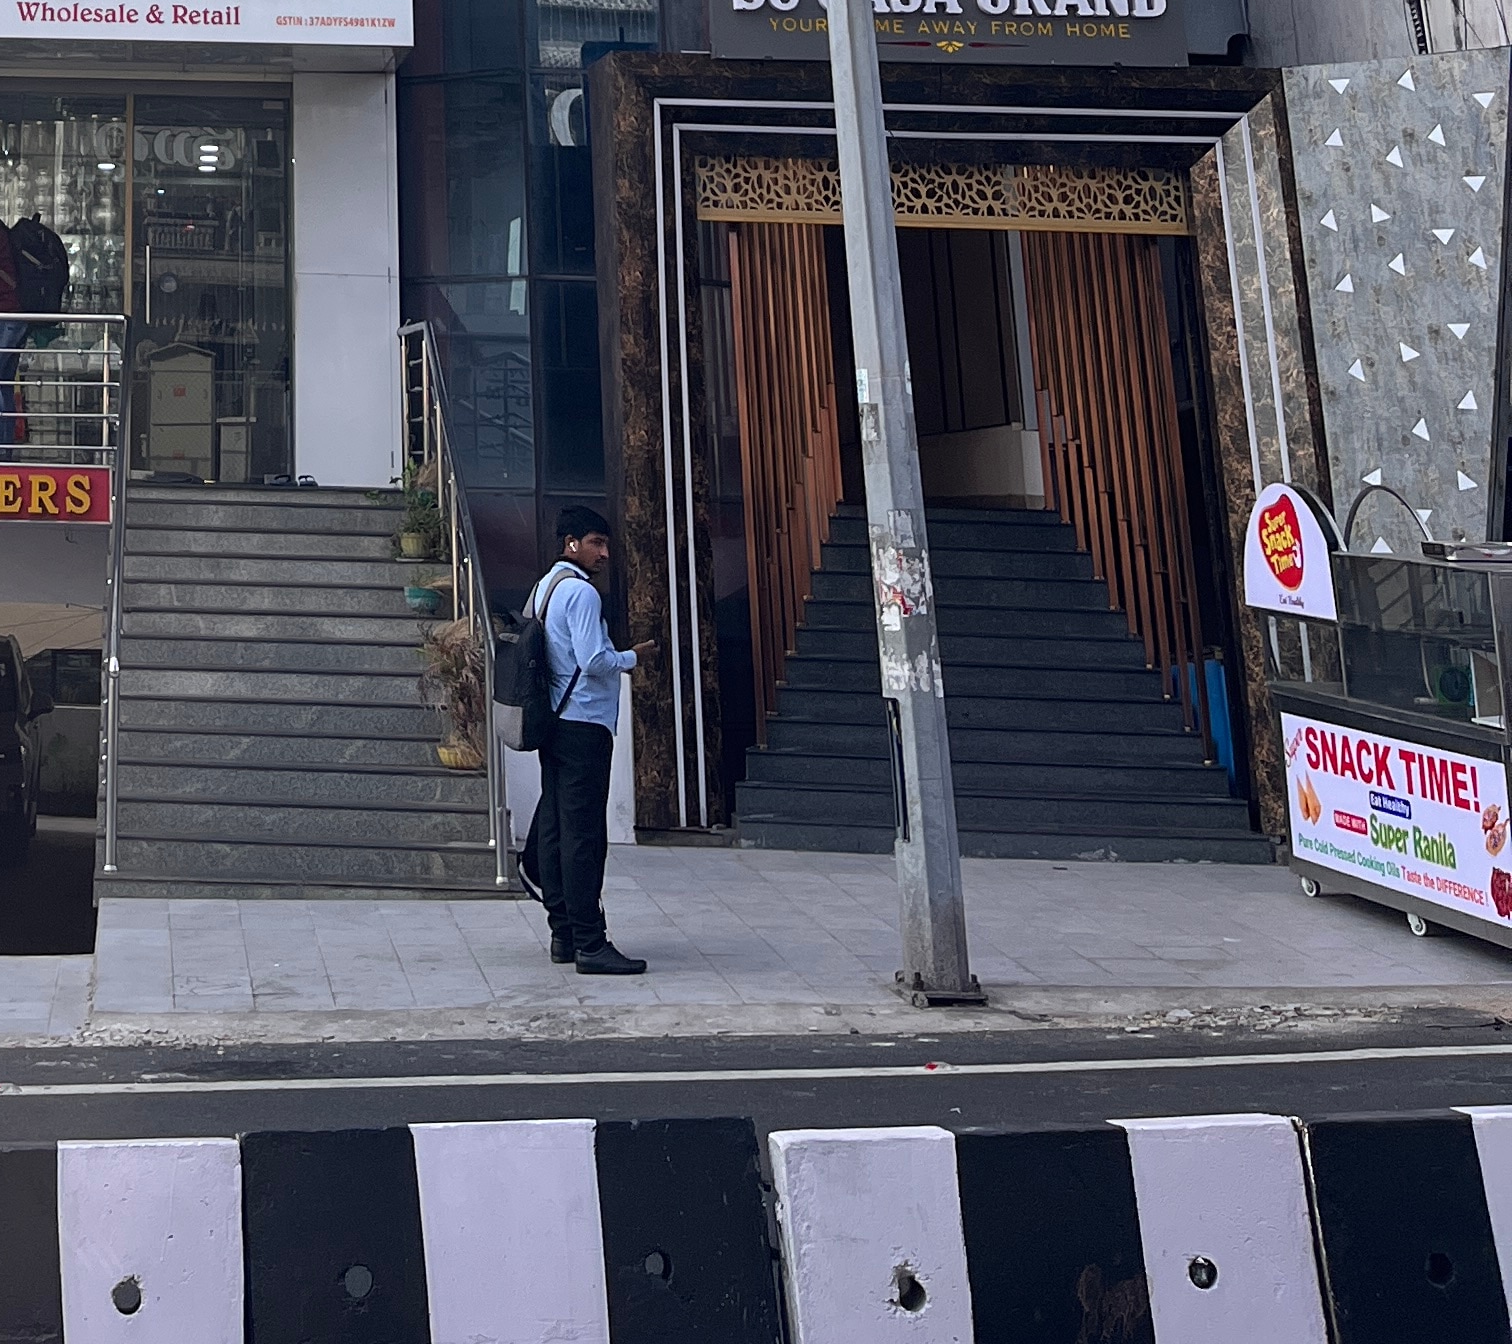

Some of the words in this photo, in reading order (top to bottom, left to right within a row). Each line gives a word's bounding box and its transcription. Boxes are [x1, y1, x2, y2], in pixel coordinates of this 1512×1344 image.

[17, 2, 138, 25] Wholesale
[146, 4, 164, 24] &
[172, 5, 240, 26] Retail
[276, 16, 303, 26] GSTIN
[769, 16, 827, 33] YOUR
[876, 19, 905, 35] ME
[918, 20, 978, 36] AWAY
[991, 21, 1053, 38] FROM
[1066, 23, 1132, 39] HOME
[1305, 727, 1396, 790] SNACK
[1399, 749, 1481, 813] TIME!
[1369, 813, 1409, 855] Super
[1436, 876, 1485, 905] DIFFERENCE
